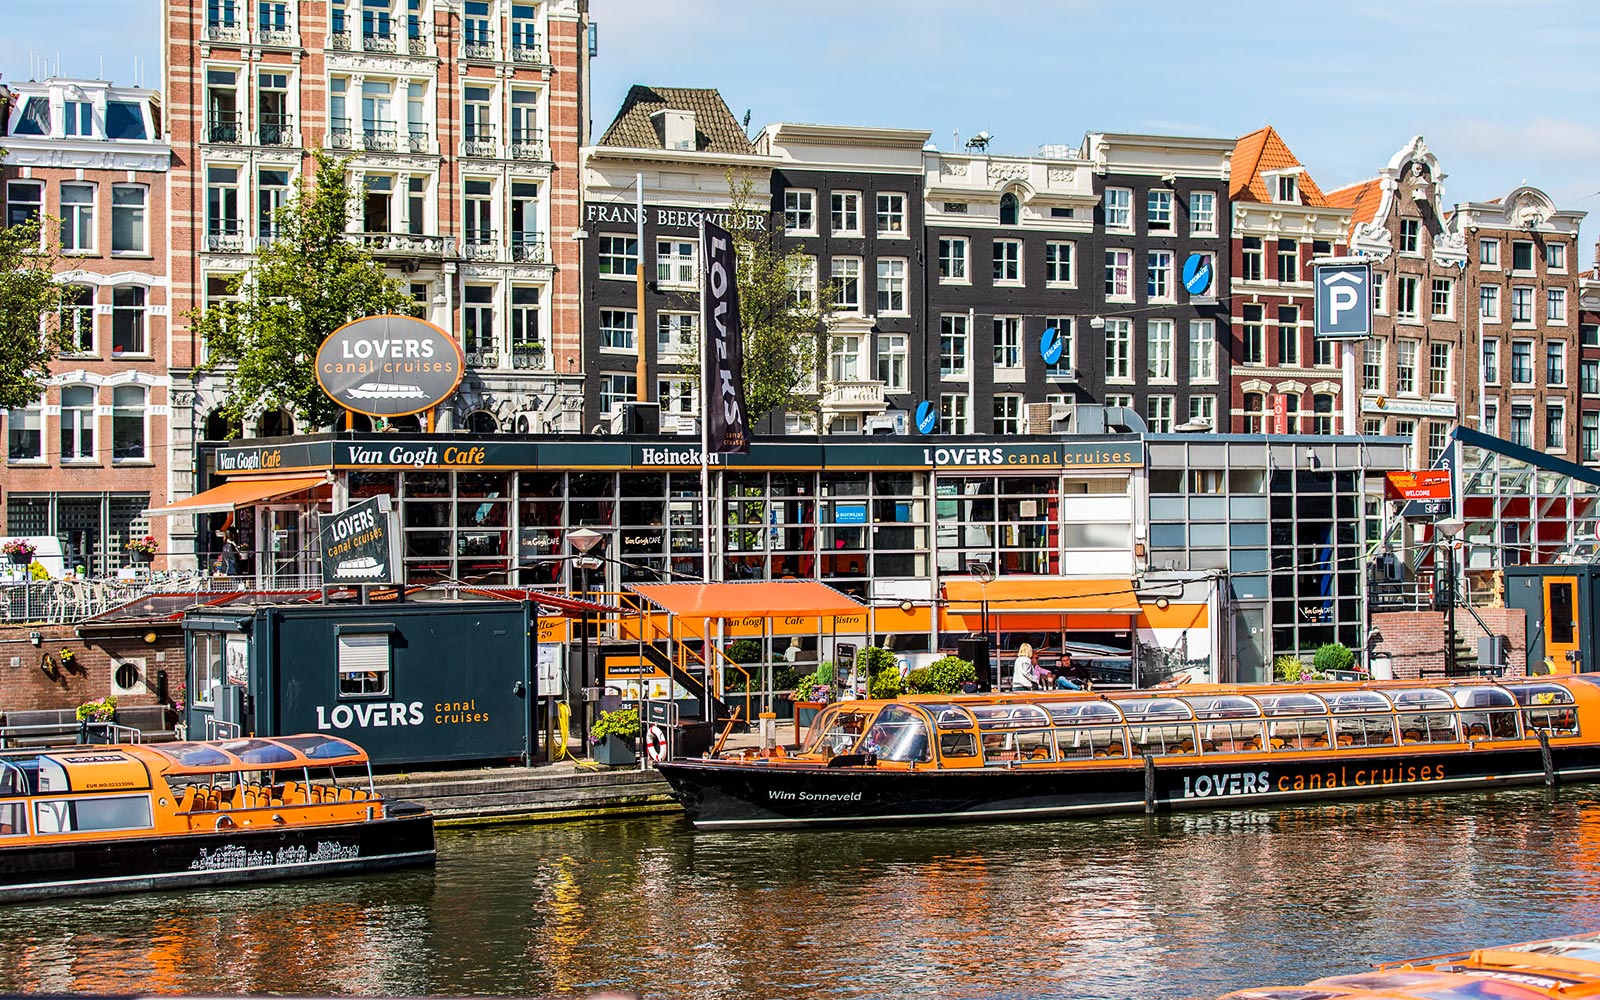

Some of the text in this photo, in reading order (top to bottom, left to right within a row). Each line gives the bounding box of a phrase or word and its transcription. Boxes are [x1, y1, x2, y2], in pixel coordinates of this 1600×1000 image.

[587, 205, 648, 225] FRANS
[1329, 285, 1358, 325] P
[342, 338, 434, 359] LOVERS
[324, 359, 453, 373] canal cruises
[1275, 395, 1283, 434] HOTE
[219, 450, 281, 471] Van Gogh Café
[348, 446, 486, 468] Van Gogh Café
[923, 448, 1131, 465] LOVERS canal cruises
[1404, 489, 1430, 497] WELCOME
[331, 508, 375, 542] LOVERS
[328, 526, 383, 558] canal cruises
[537, 619, 555, 630] ffee
[316, 702, 424, 730] LOVERS
[435, 699, 475, 712] canal
[435, 710, 489, 724] cruises
[1182, 762, 1445, 798] LOVERS canal cruises
[768, 789, 863, 802] Wim Sonneveld
